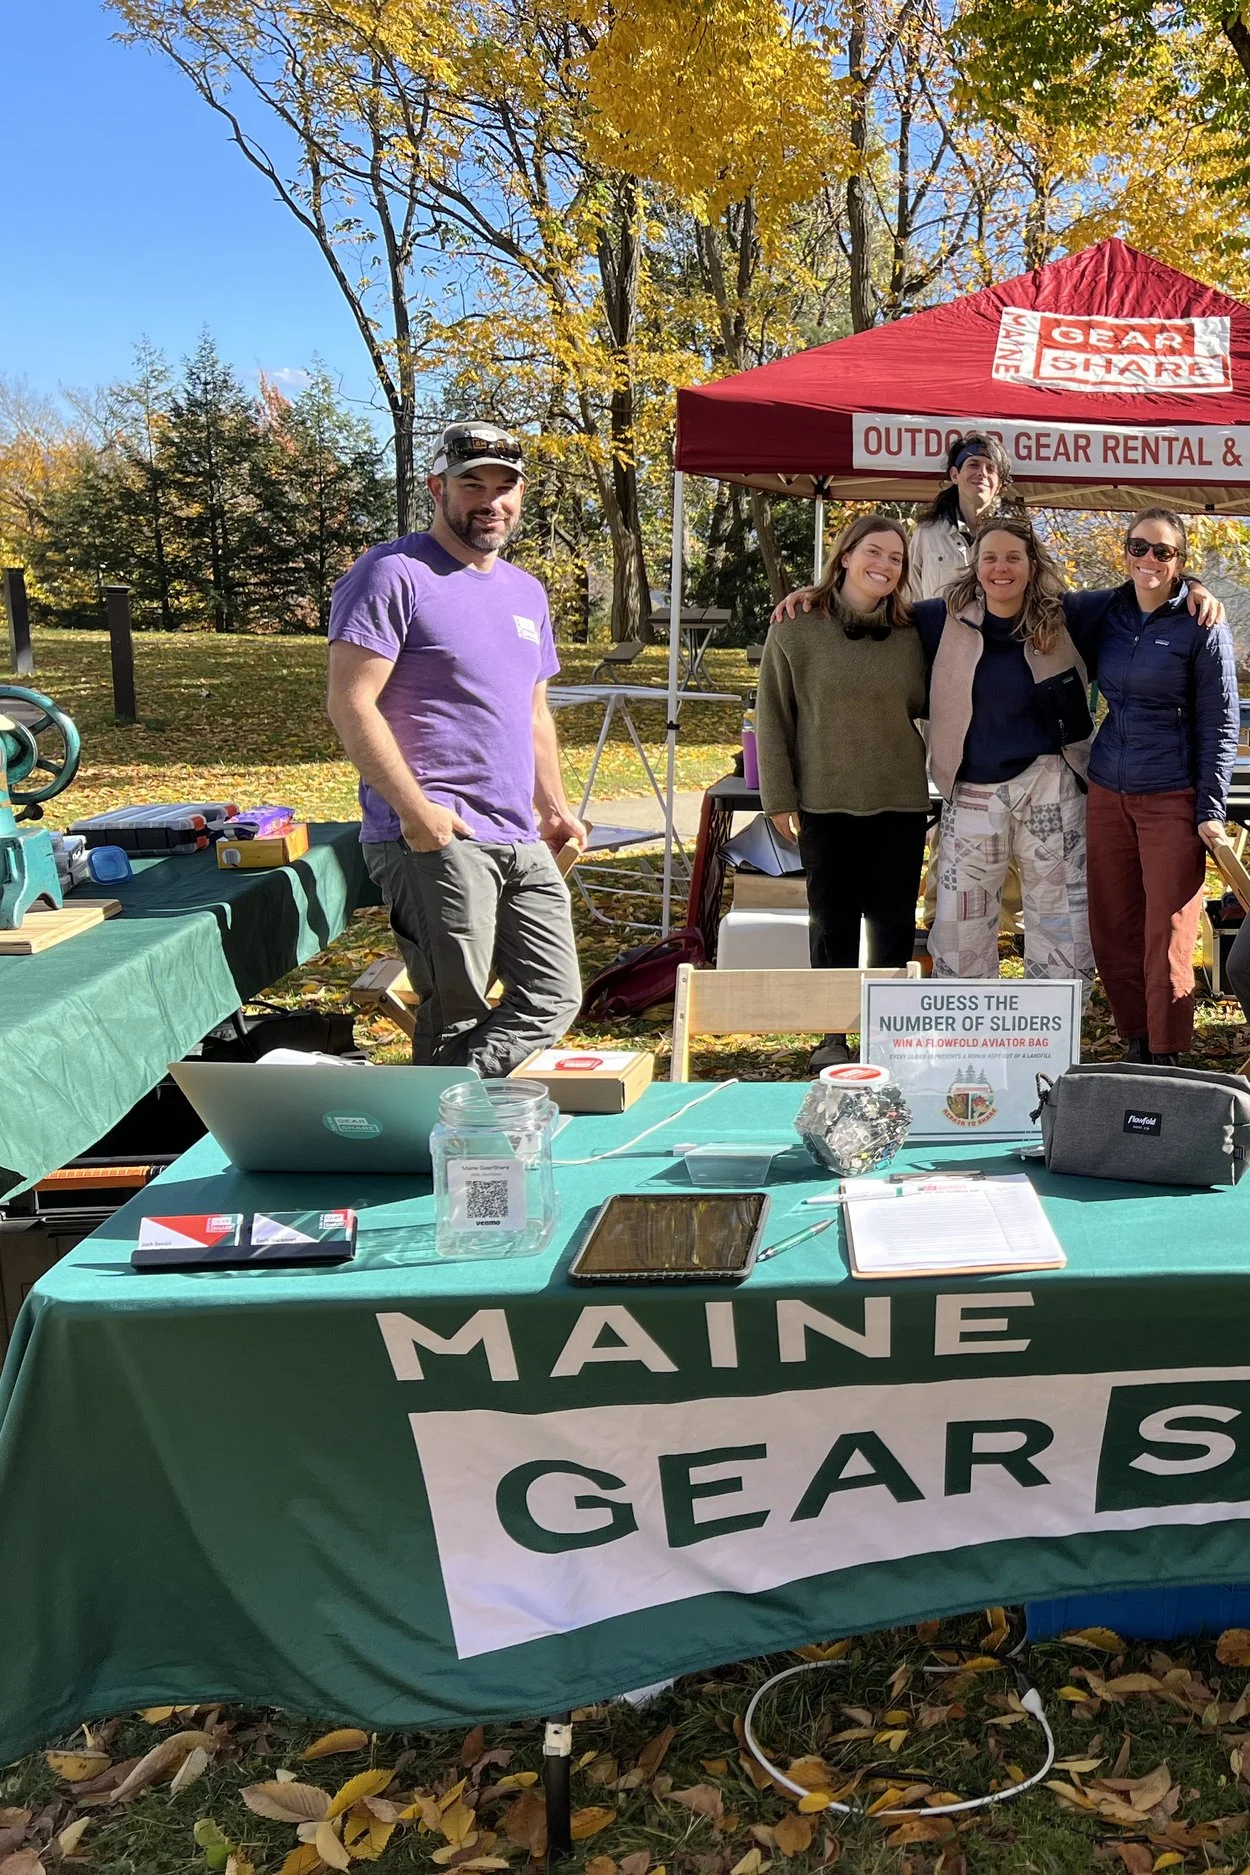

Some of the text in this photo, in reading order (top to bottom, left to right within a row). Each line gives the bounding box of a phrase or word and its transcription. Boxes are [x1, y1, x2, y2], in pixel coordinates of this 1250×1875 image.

[995, 310, 1026, 374] MAINE
[1050, 326, 1184, 350] GEAR
[1049, 356, 1213, 378] SHARE
[864, 425, 1003, 457] OUTDO
[1014, 432, 1092, 463] GEAR
[1102, 434, 1213, 466] RENTAL
[1221, 437, 1242, 467] &
[920, 995, 1019, 1011] GUESS THE
[879, 1015, 1062, 1032] NUMBER OF SLIDERS
[893, 1038, 1049, 1048] WIN A FLOWFOLD AVIATOR BAG
[1128, 1115, 1157, 1125] flowfold
[375, 1291, 1035, 1382] MAINE
[494, 1417, 1055, 1555] GEAR
